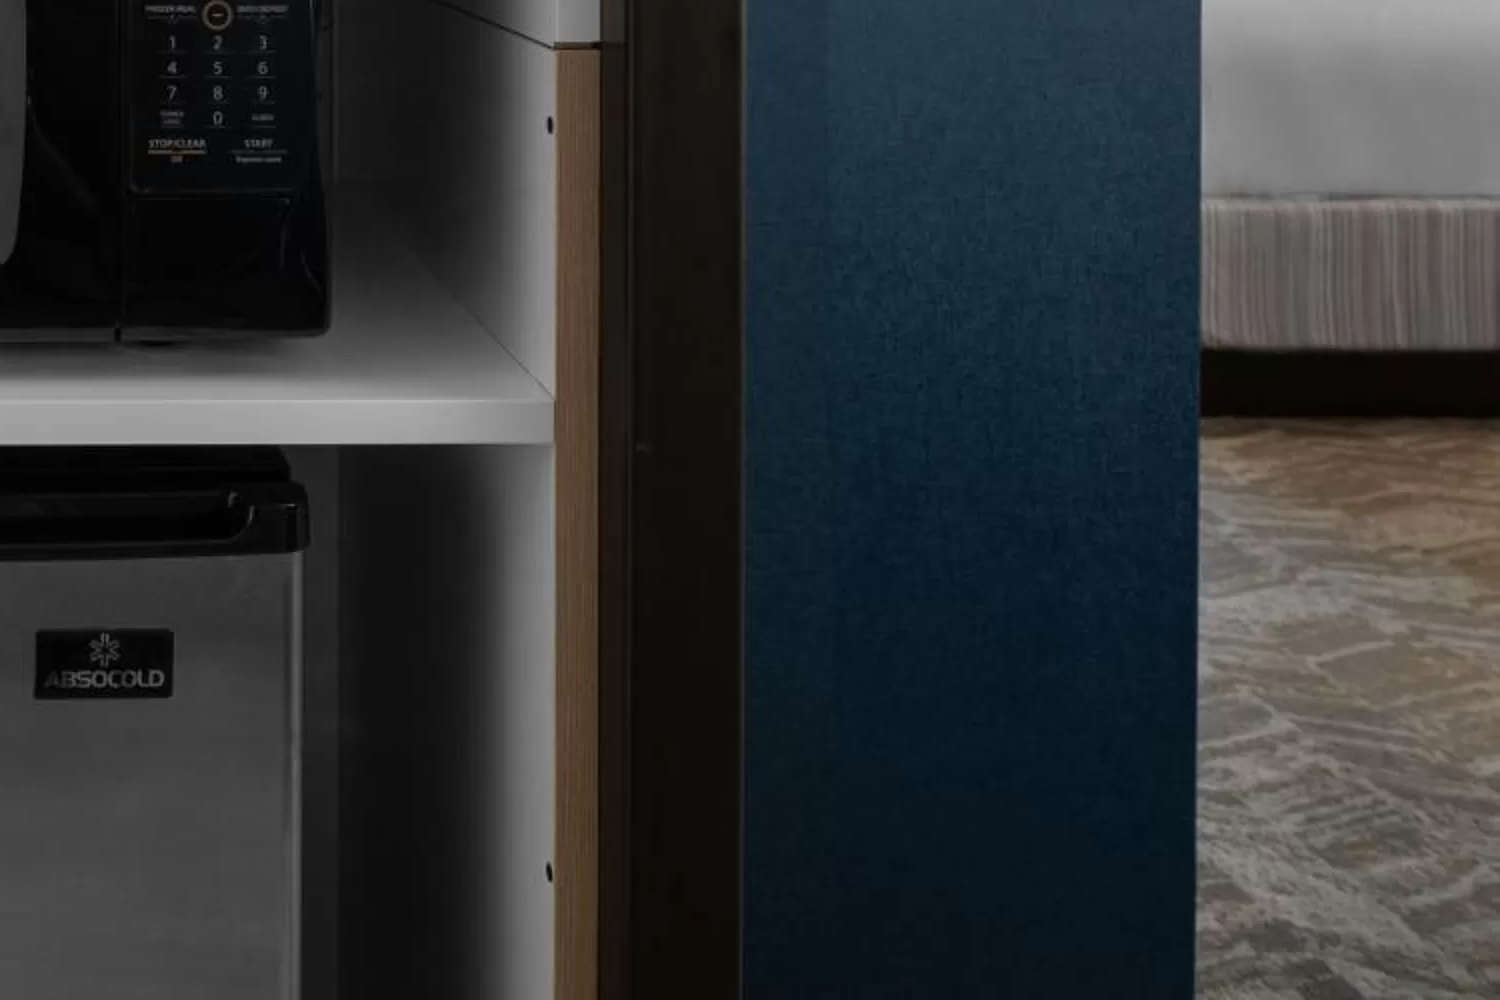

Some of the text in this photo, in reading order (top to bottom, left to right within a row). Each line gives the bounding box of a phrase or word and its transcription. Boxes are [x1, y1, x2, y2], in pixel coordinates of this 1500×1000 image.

[168, 35, 177, 50] 1
[212, 35, 223, 50] 2
[258, 35, 268, 50] 3
[167, 61, 177, 76] 4
[212, 61, 223, 76] 5
[258, 61, 268, 76] 6
[167, 86, 177, 101] 7
[212, 86, 223, 101] 8
[258, 86, 268, 101] 9
[44, 669, 165, 689] ABSOCOLD
